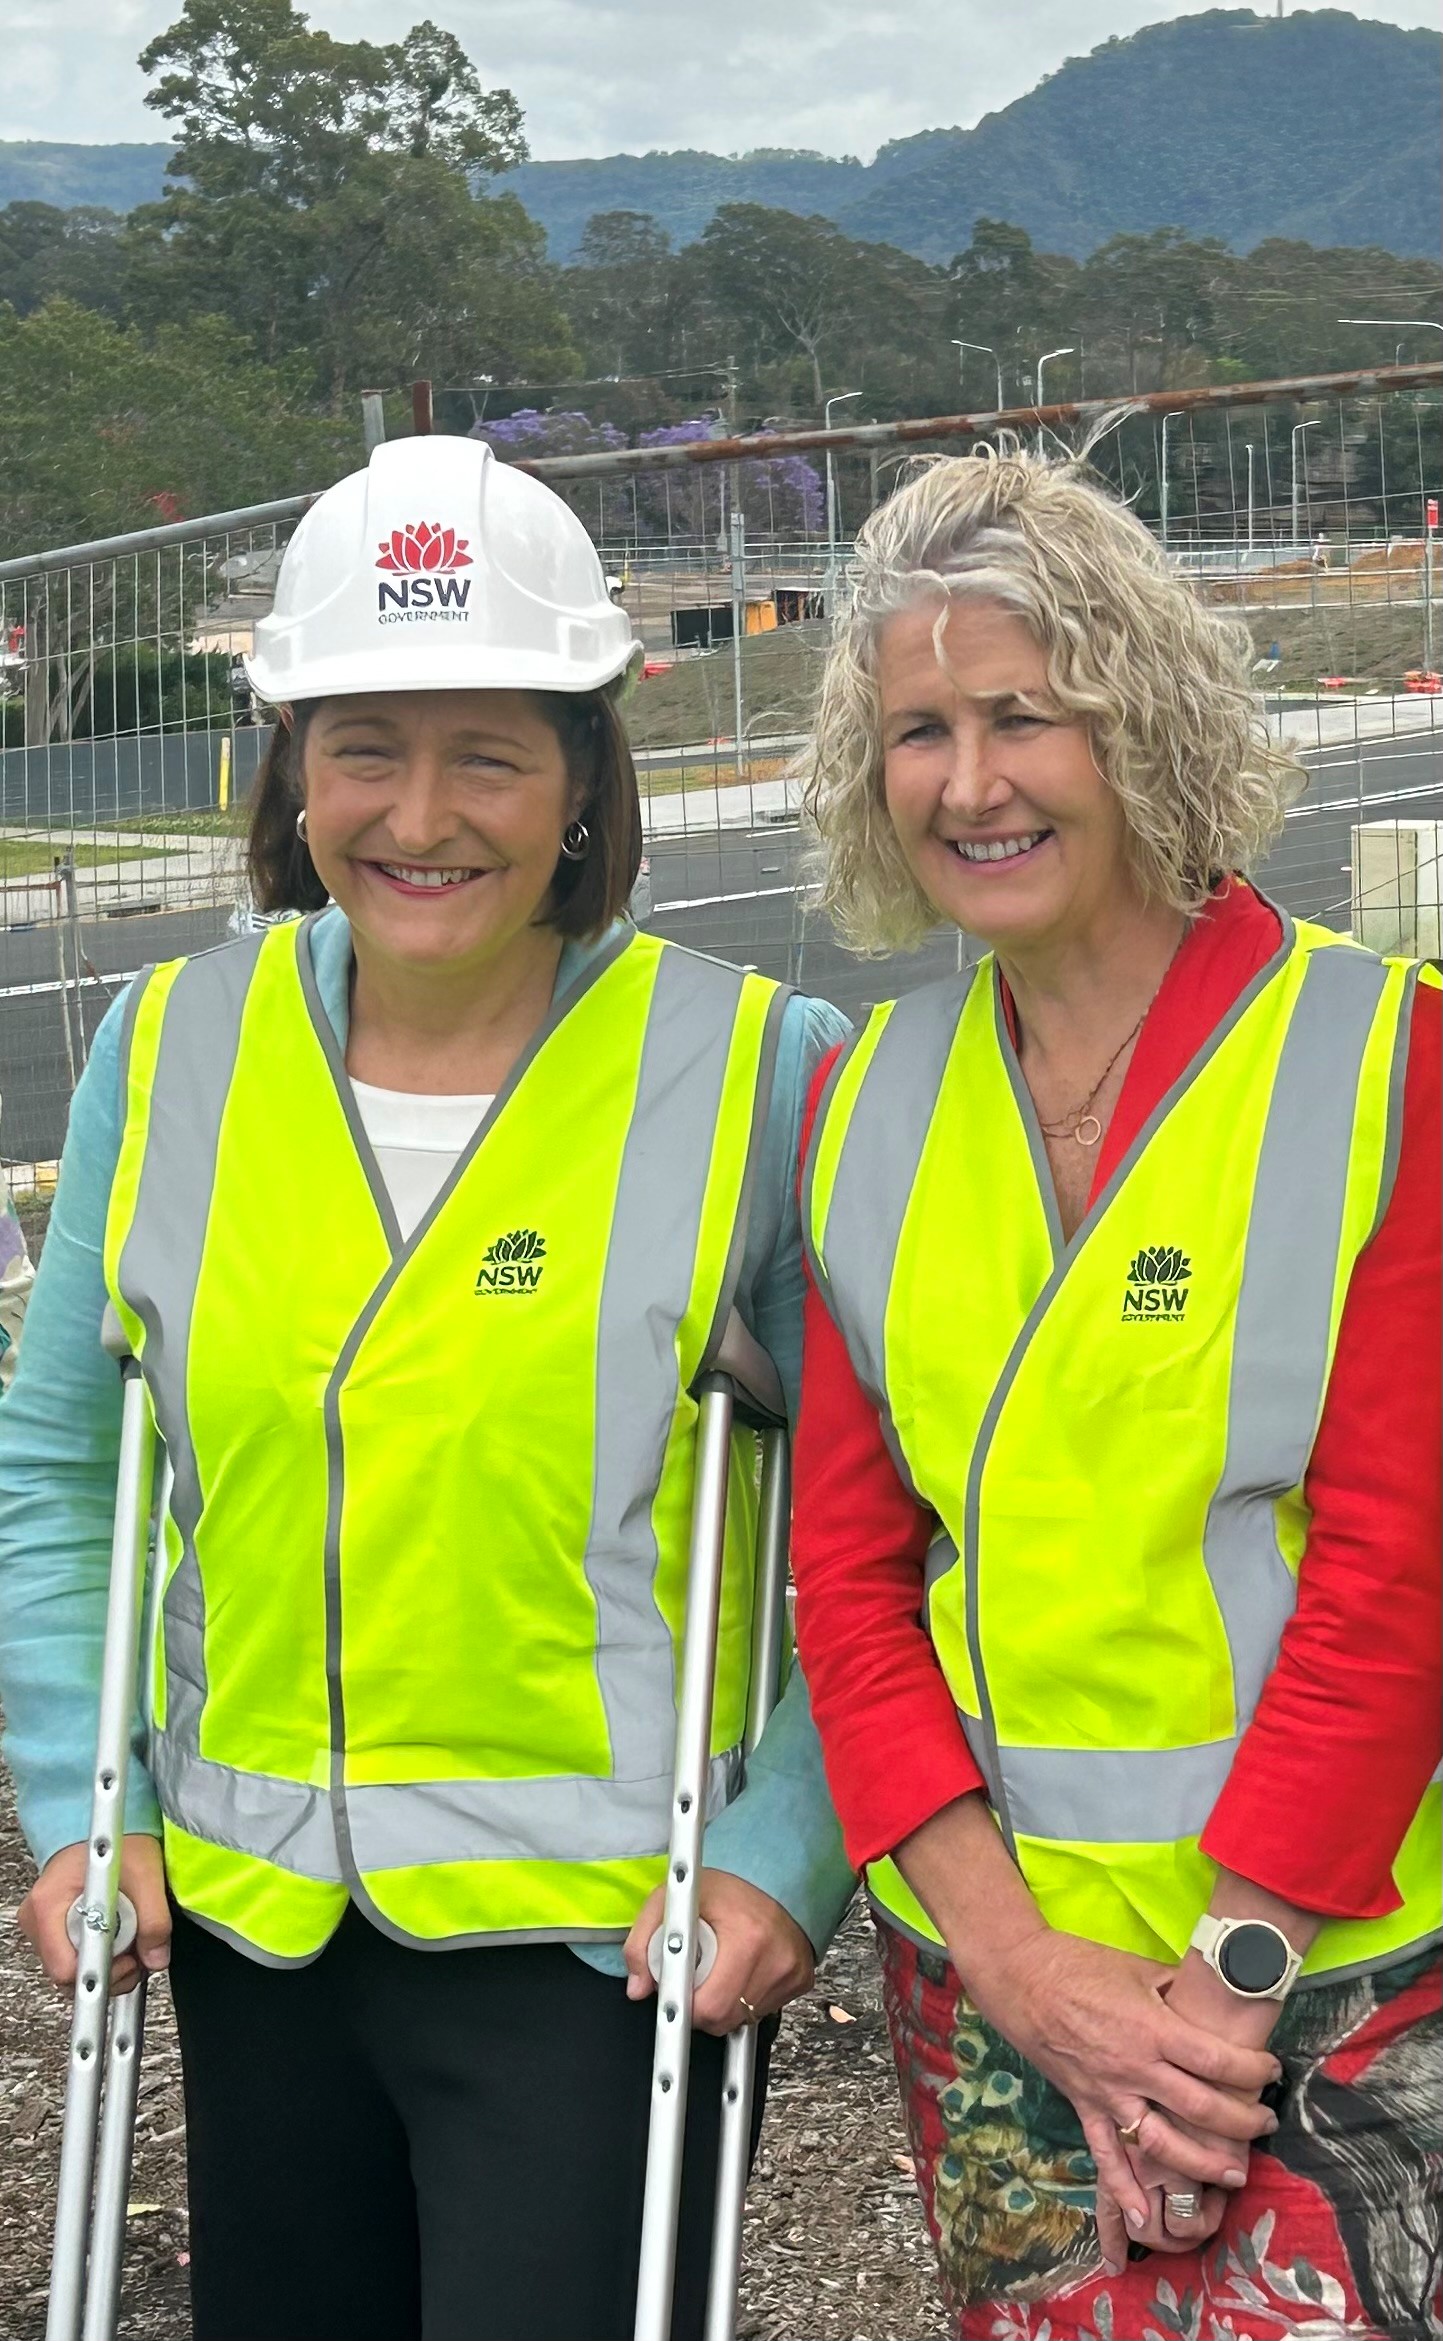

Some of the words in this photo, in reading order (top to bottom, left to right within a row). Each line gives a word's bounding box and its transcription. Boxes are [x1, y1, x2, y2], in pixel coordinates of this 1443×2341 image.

[378, 578, 471, 611] NSW
[476, 1266, 543, 1287] NSW
[1123, 1288, 1189, 1312] NSW
